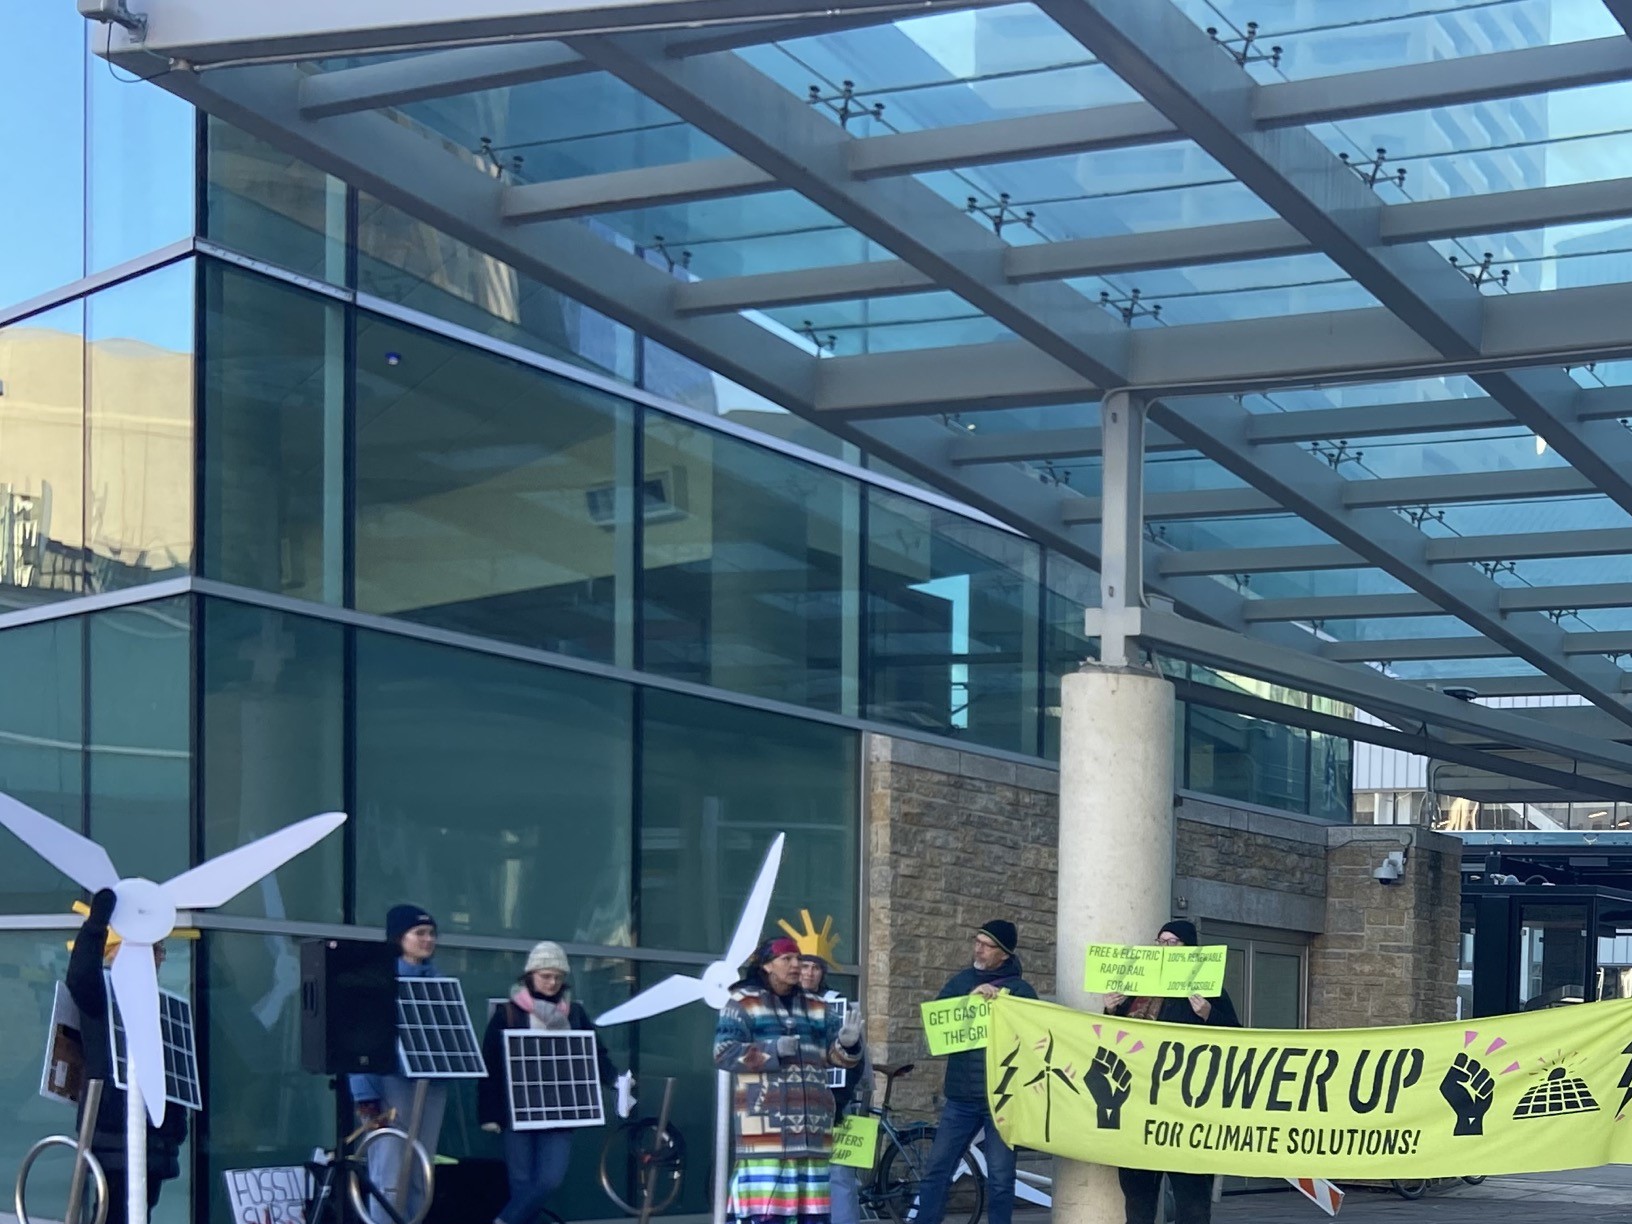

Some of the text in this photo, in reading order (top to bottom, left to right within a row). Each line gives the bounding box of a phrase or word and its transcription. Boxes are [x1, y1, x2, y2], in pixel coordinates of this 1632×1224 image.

[1089, 945, 1161, 961] FREE & ELECTRIC
[1099, 963, 1145, 976] RAPID RAIL
[1105, 979, 1139, 992] FOR ALL
[929, 1002, 993, 1026] GET GAS OF
[943, 1025, 988, 1046] THE GRI
[1149, 1041, 1424, 1114] POWER UP
[1144, 1119, 1421, 1156] FOR CLIMATE SOLUTIONS!
